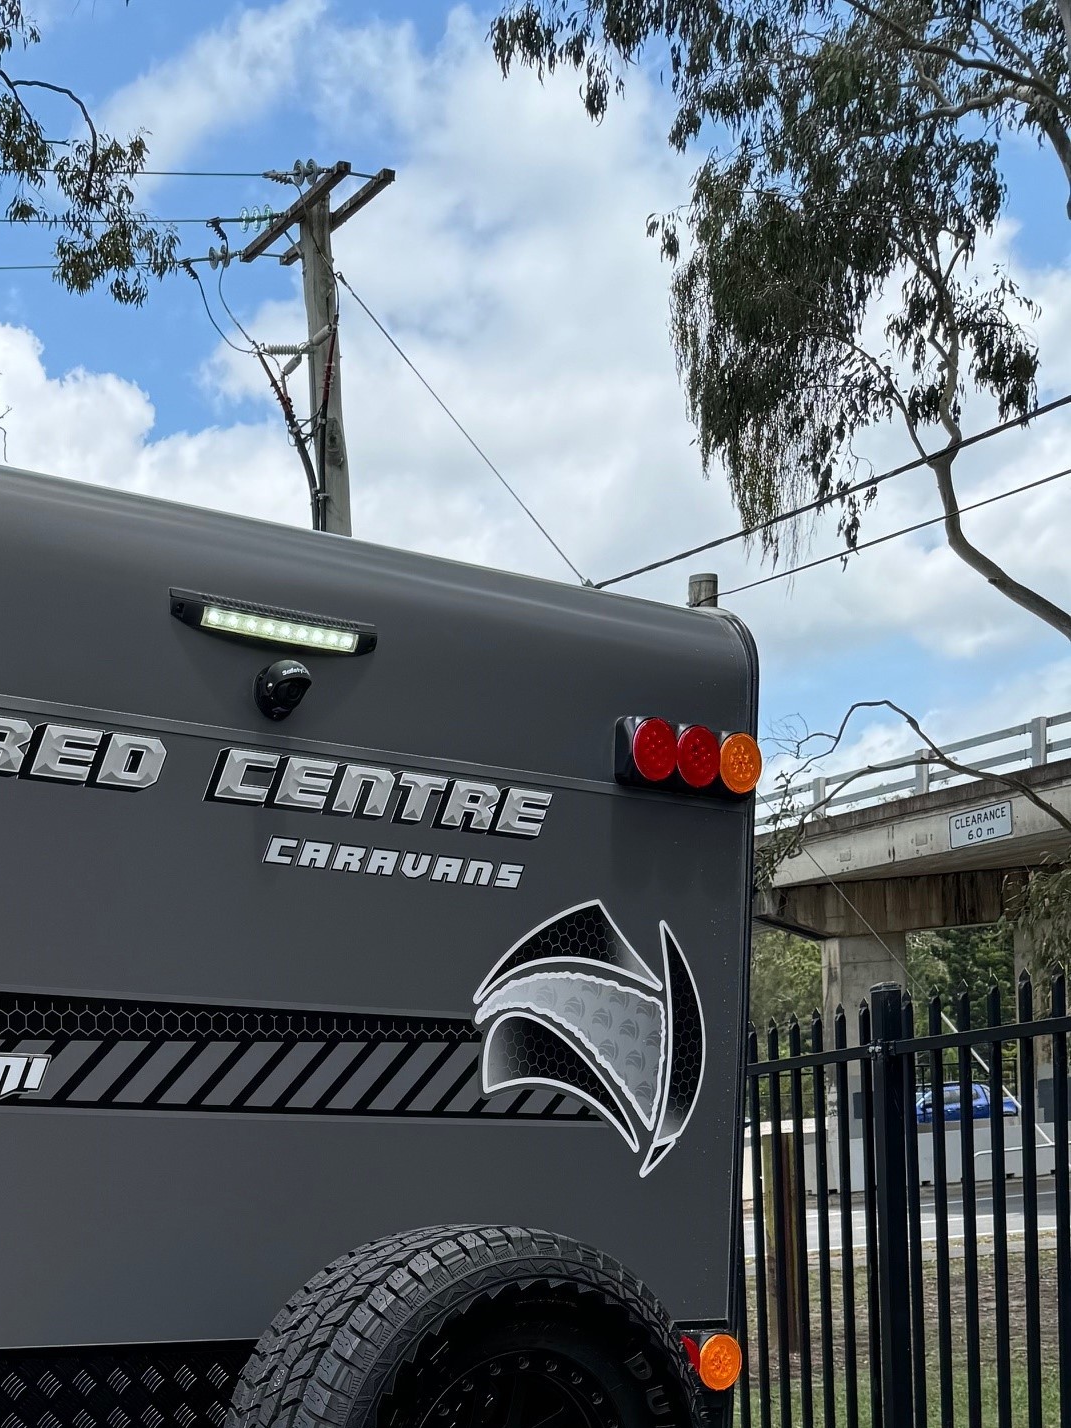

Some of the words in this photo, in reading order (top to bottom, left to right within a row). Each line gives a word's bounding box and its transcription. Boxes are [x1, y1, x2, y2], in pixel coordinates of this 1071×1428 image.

[204, 747, 554, 838] CENTRE
[955, 806, 1006, 830] CLEARANCE
[968, 827, 983, 841] 6.0
[986, 826, 995, 836] m
[262, 834, 526, 889] CARAVANS
